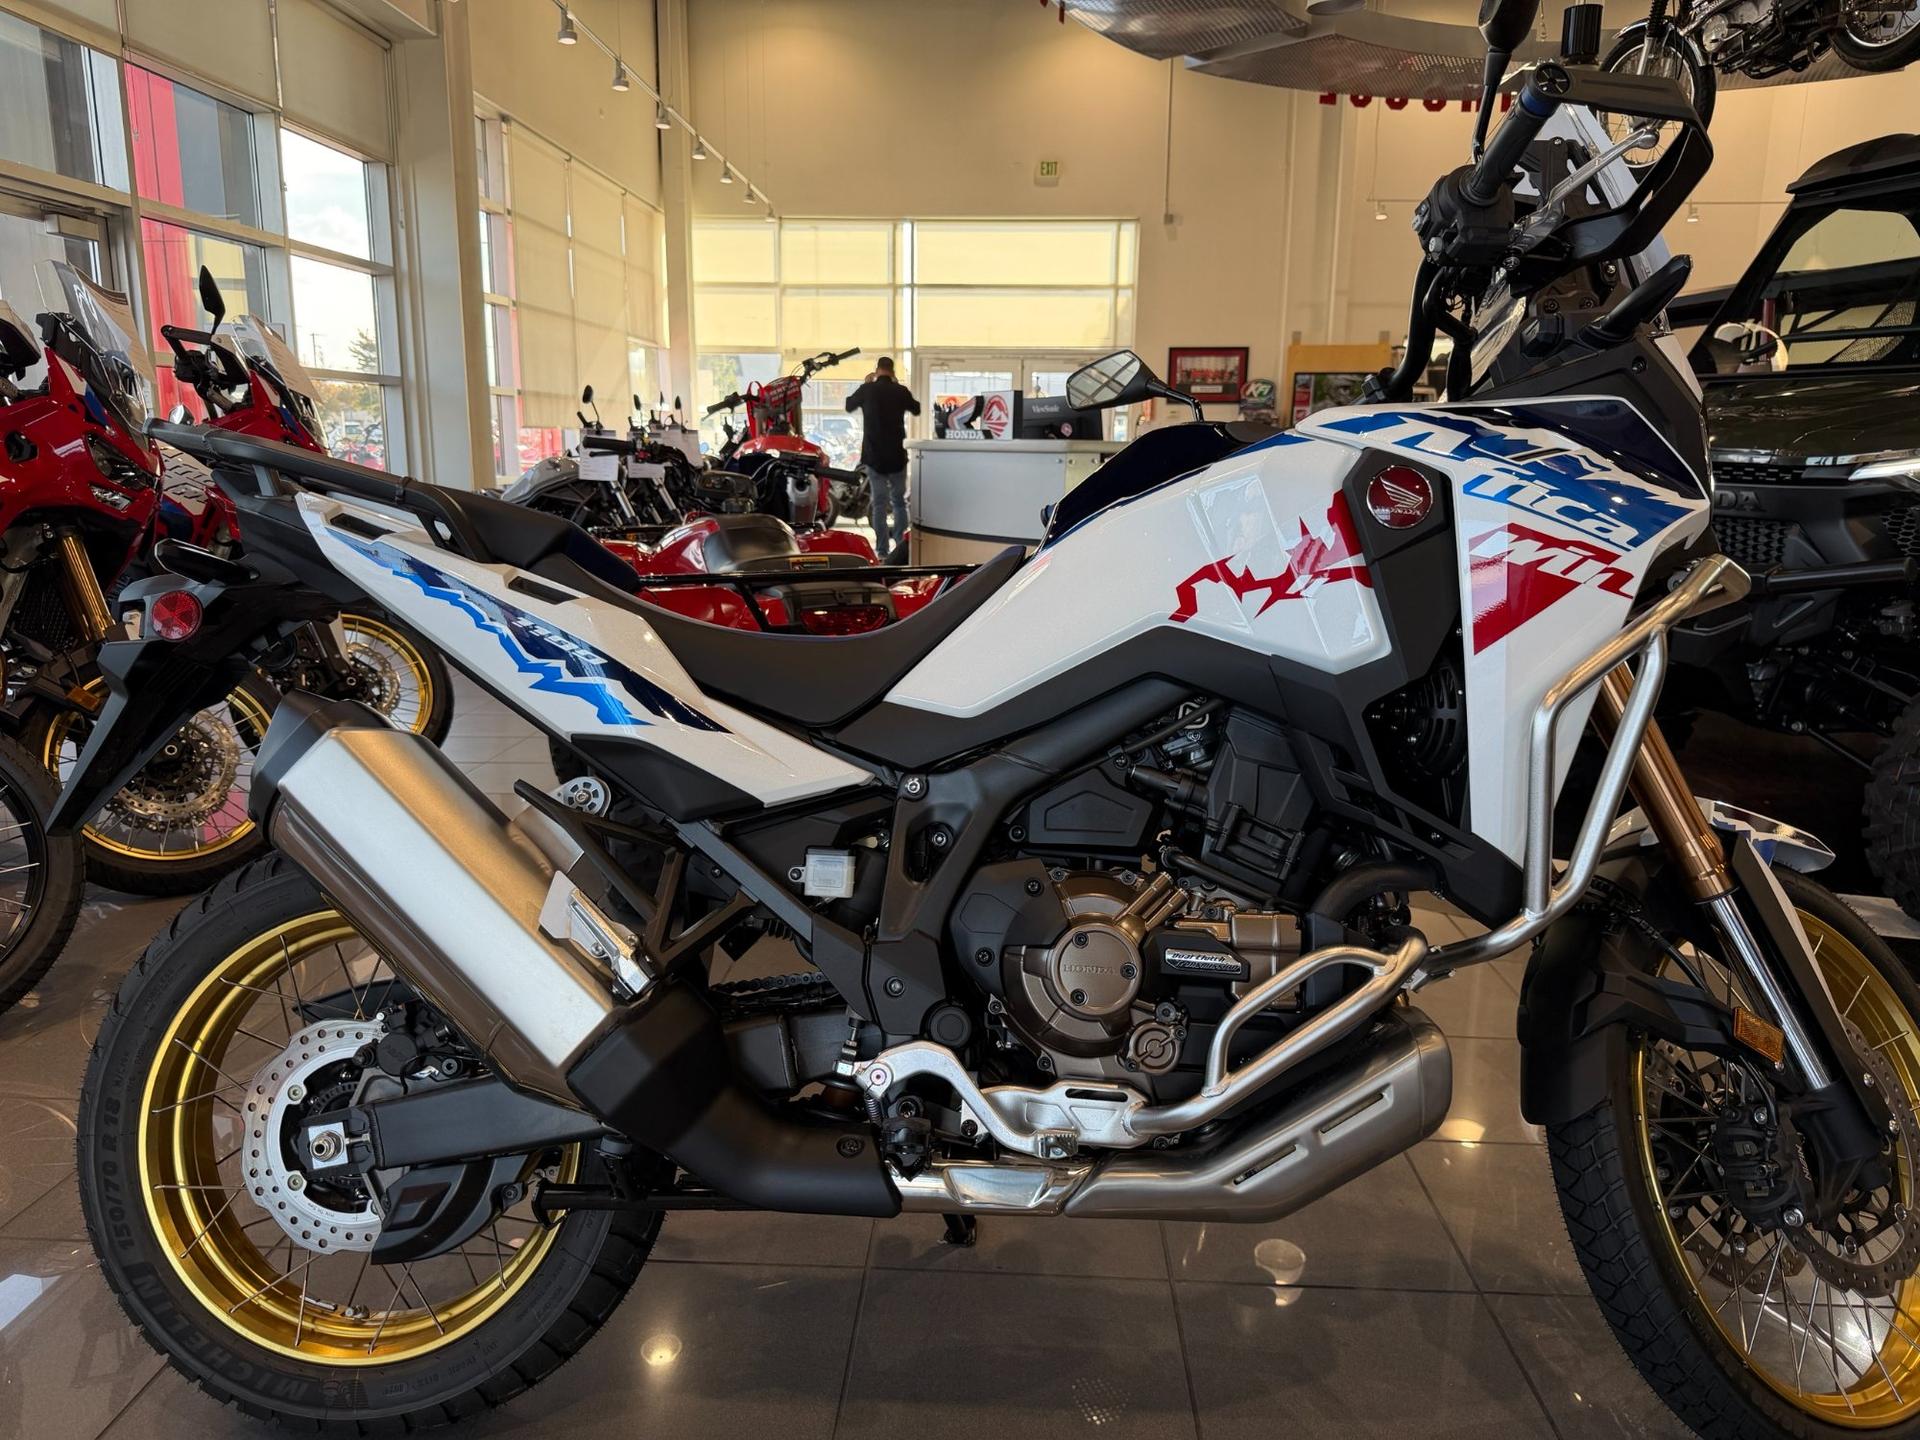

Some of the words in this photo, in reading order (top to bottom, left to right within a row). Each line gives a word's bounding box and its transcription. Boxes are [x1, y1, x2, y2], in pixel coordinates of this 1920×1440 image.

[1041, 161, 1057, 176] EXIT
[945, 430, 984, 440] HONDA
[512, 616, 608, 665] 1100
[1195, 954, 1226, 962] Clutch
[1063, 964, 1116, 976] HONDA
[103, 1099, 121, 1126] 18
[102, 1135, 117, 1152] R
[103, 1161, 135, 1250] 150/70
[131, 1273, 309, 1399] MICHELIN
